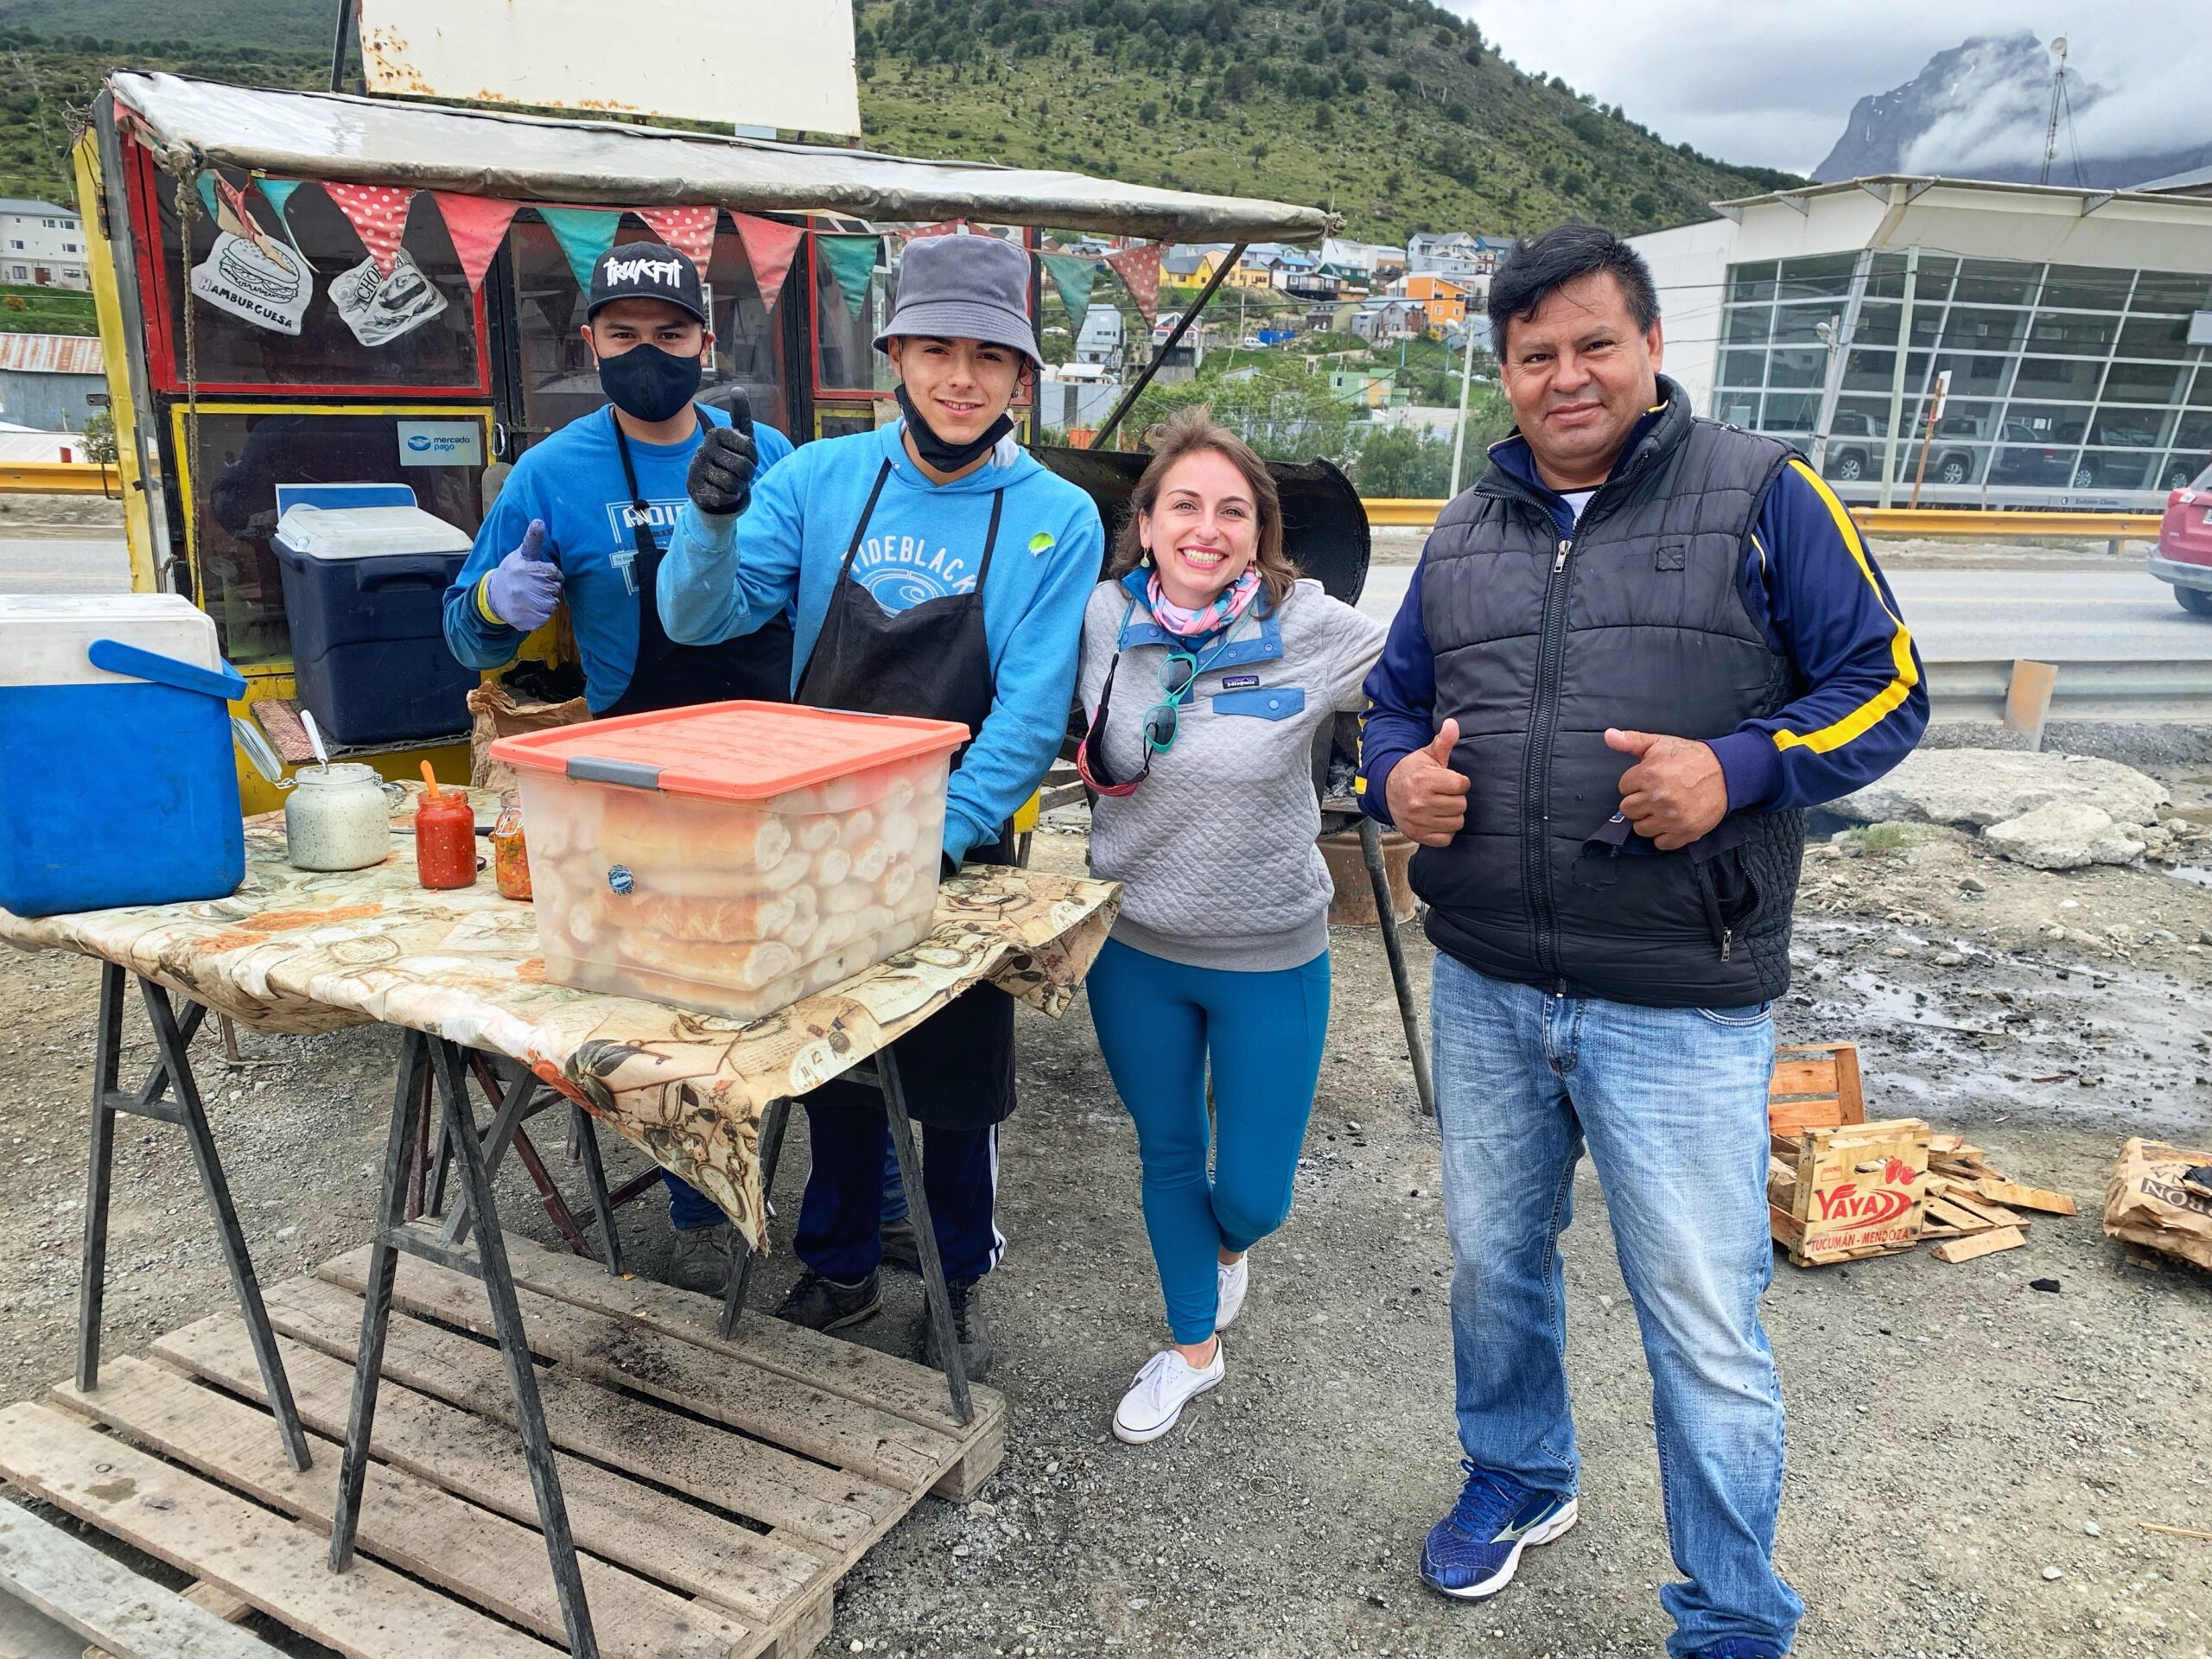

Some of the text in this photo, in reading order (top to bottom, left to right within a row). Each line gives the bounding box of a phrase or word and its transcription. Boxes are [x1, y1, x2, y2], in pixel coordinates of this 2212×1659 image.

[198, 276, 293, 329] HAMBURGUESA
[434, 443, 454, 452] pago
[1816, 1184, 1879, 1221] YAYA
[1810, 1232, 1855, 1252] TUCUMÁN
[1861, 1228, 1909, 1244] MENDOZA
